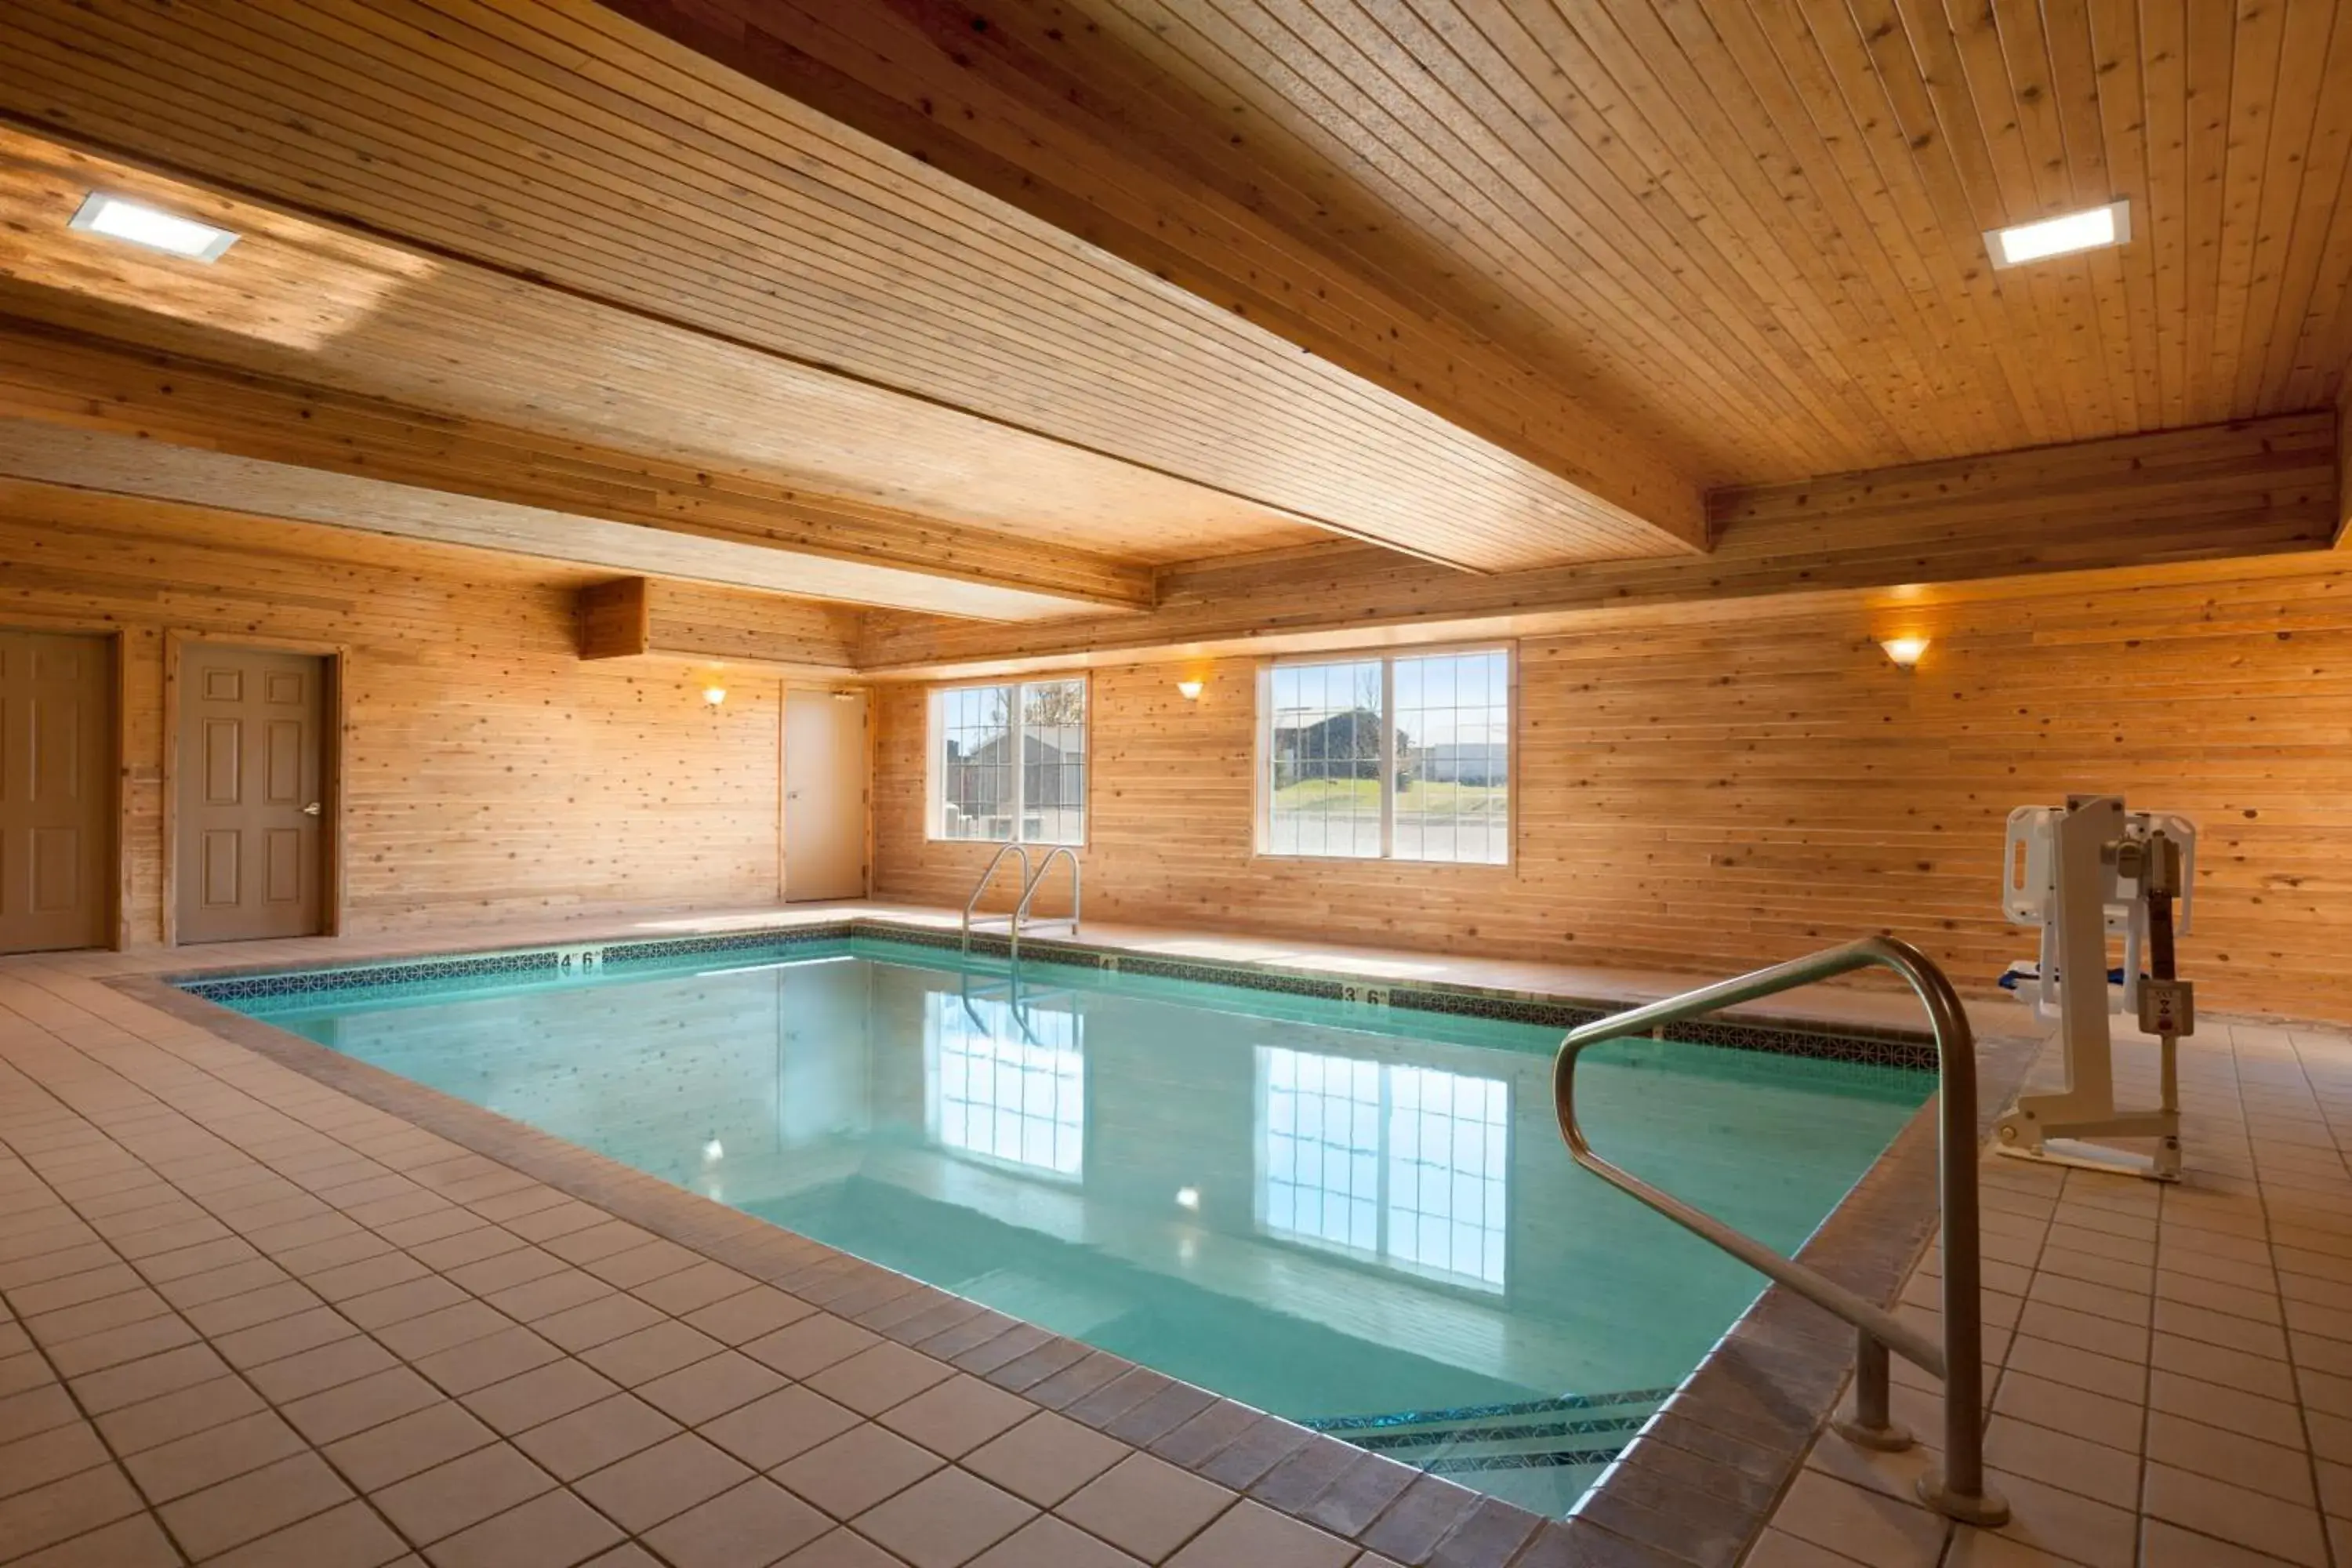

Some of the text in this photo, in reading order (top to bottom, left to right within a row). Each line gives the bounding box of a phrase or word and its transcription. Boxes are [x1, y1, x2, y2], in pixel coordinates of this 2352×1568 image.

[561, 954, 571, 967] 4
[583, 952, 593, 965] 6
[1345, 987, 1356, 1002] 3
[1367, 989, 1378, 1004] 6
